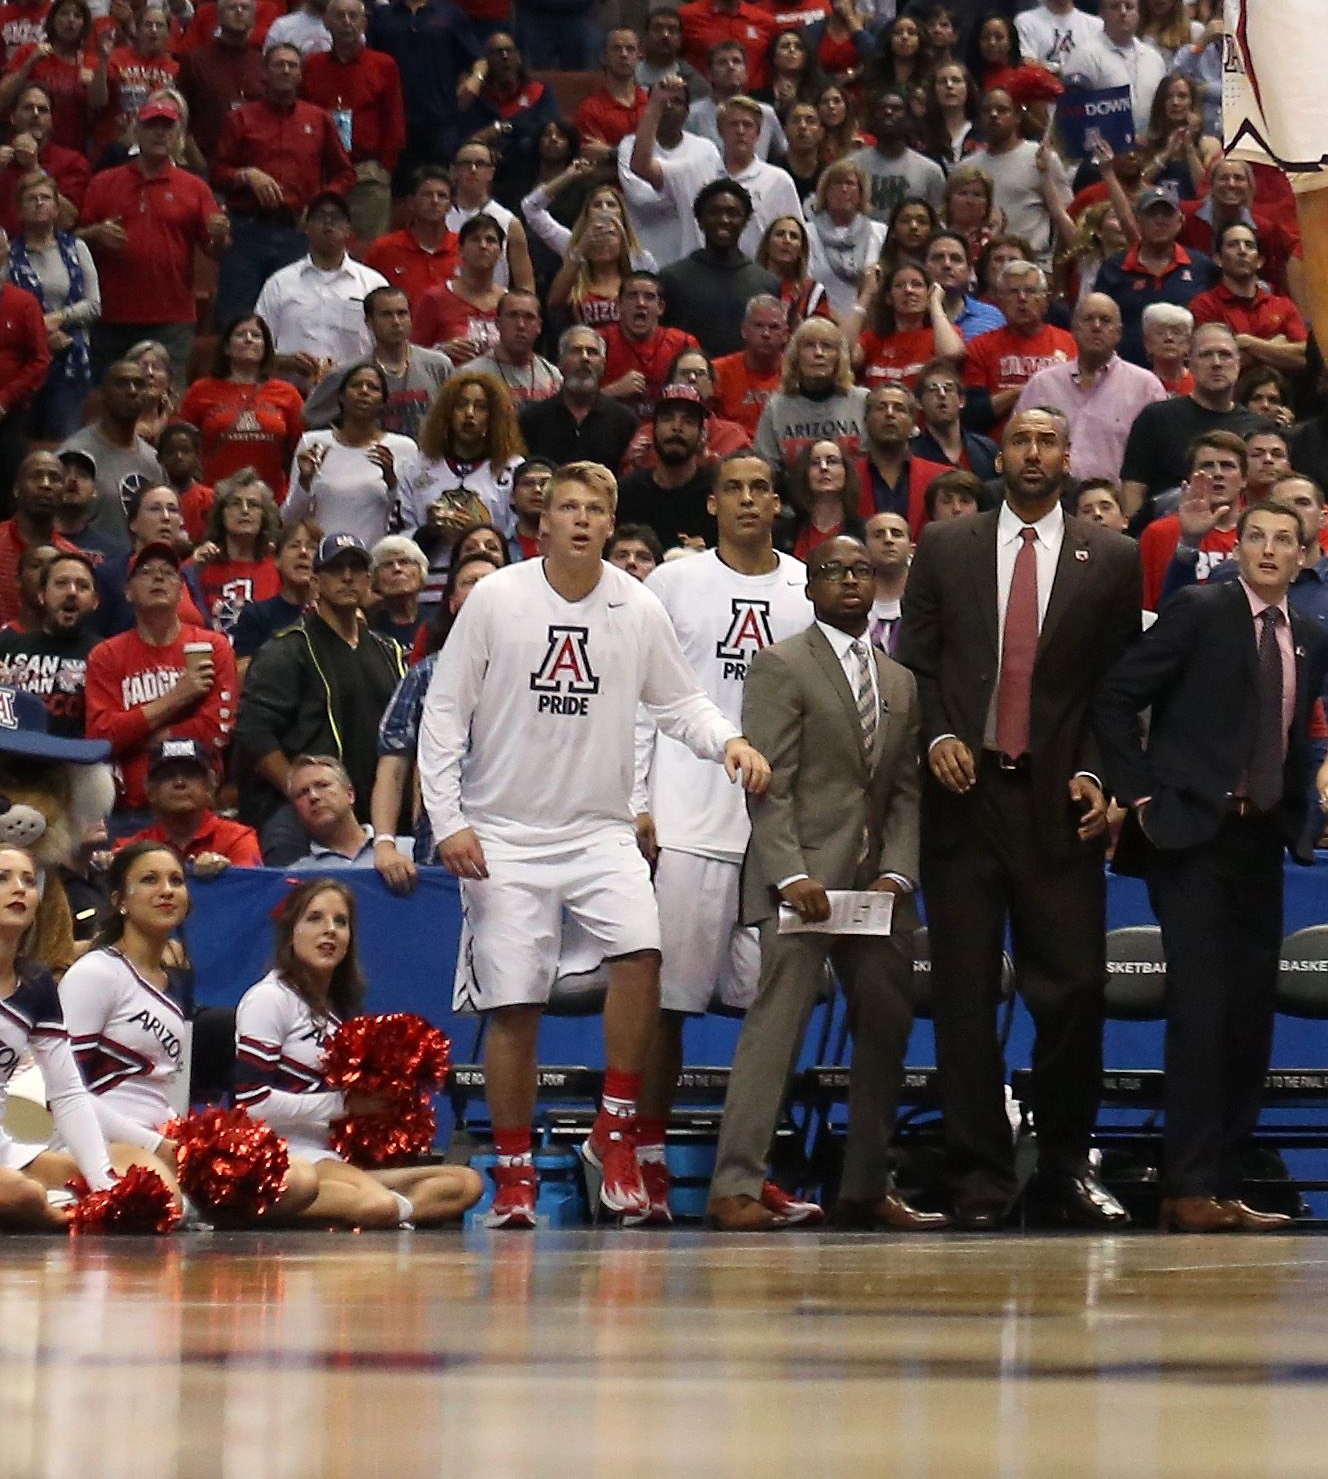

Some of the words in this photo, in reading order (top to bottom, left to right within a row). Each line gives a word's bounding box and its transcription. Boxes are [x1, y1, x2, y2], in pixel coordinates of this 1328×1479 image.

[1085, 98, 1131, 117] DOWN
[783, 419, 861, 439] ARIZONA
[537, 695, 591, 717] PRIDE
[128, 1009, 182, 1063] ARIZO
